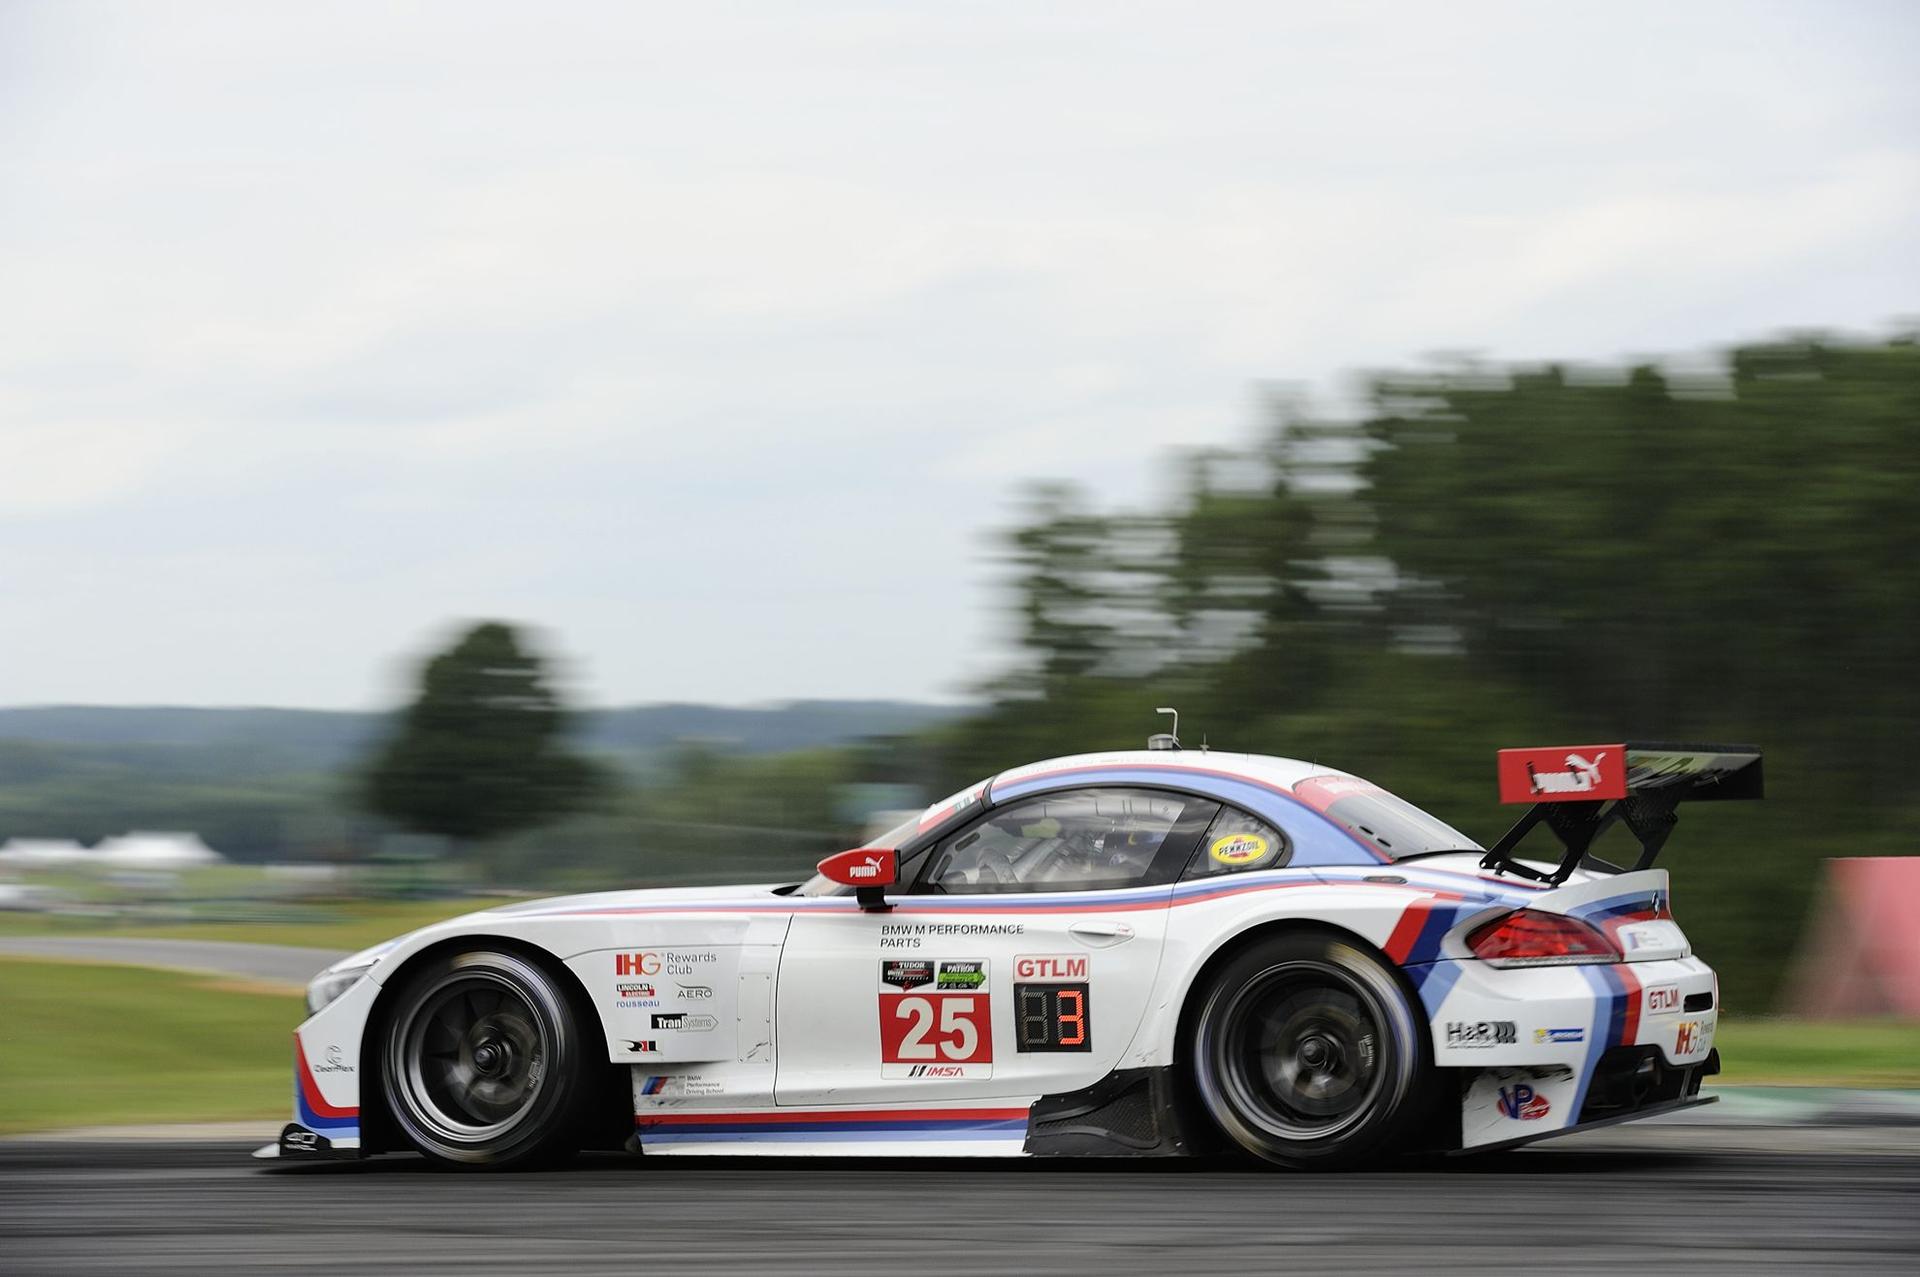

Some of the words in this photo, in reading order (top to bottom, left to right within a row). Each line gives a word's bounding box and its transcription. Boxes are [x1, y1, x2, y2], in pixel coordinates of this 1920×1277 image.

[849, 865, 877, 878] PUMA
[881, 924, 913, 935] BMW
[914, 925, 926, 935] M
[928, 924, 1024, 935] PERFORMANCE
[880, 937, 921, 948] PARTS
[616, 953, 662, 976] IHG
[666, 952, 717, 963] Rewards
[666, 964, 693, 976] Club
[898, 961, 925, 969] TUDOR
[1017, 958, 1086, 977] GTLM
[617, 983, 649, 992] LINCOLN
[677, 990, 713, 999] AERO
[1648, 989, 1678, 1010] GTLM
[616, 1000, 660, 1008] rousseau
[895, 996, 979, 1061] 25
[926, 1066, 964, 1078] IMSA
[1498, 1084, 1534, 1120] VP
